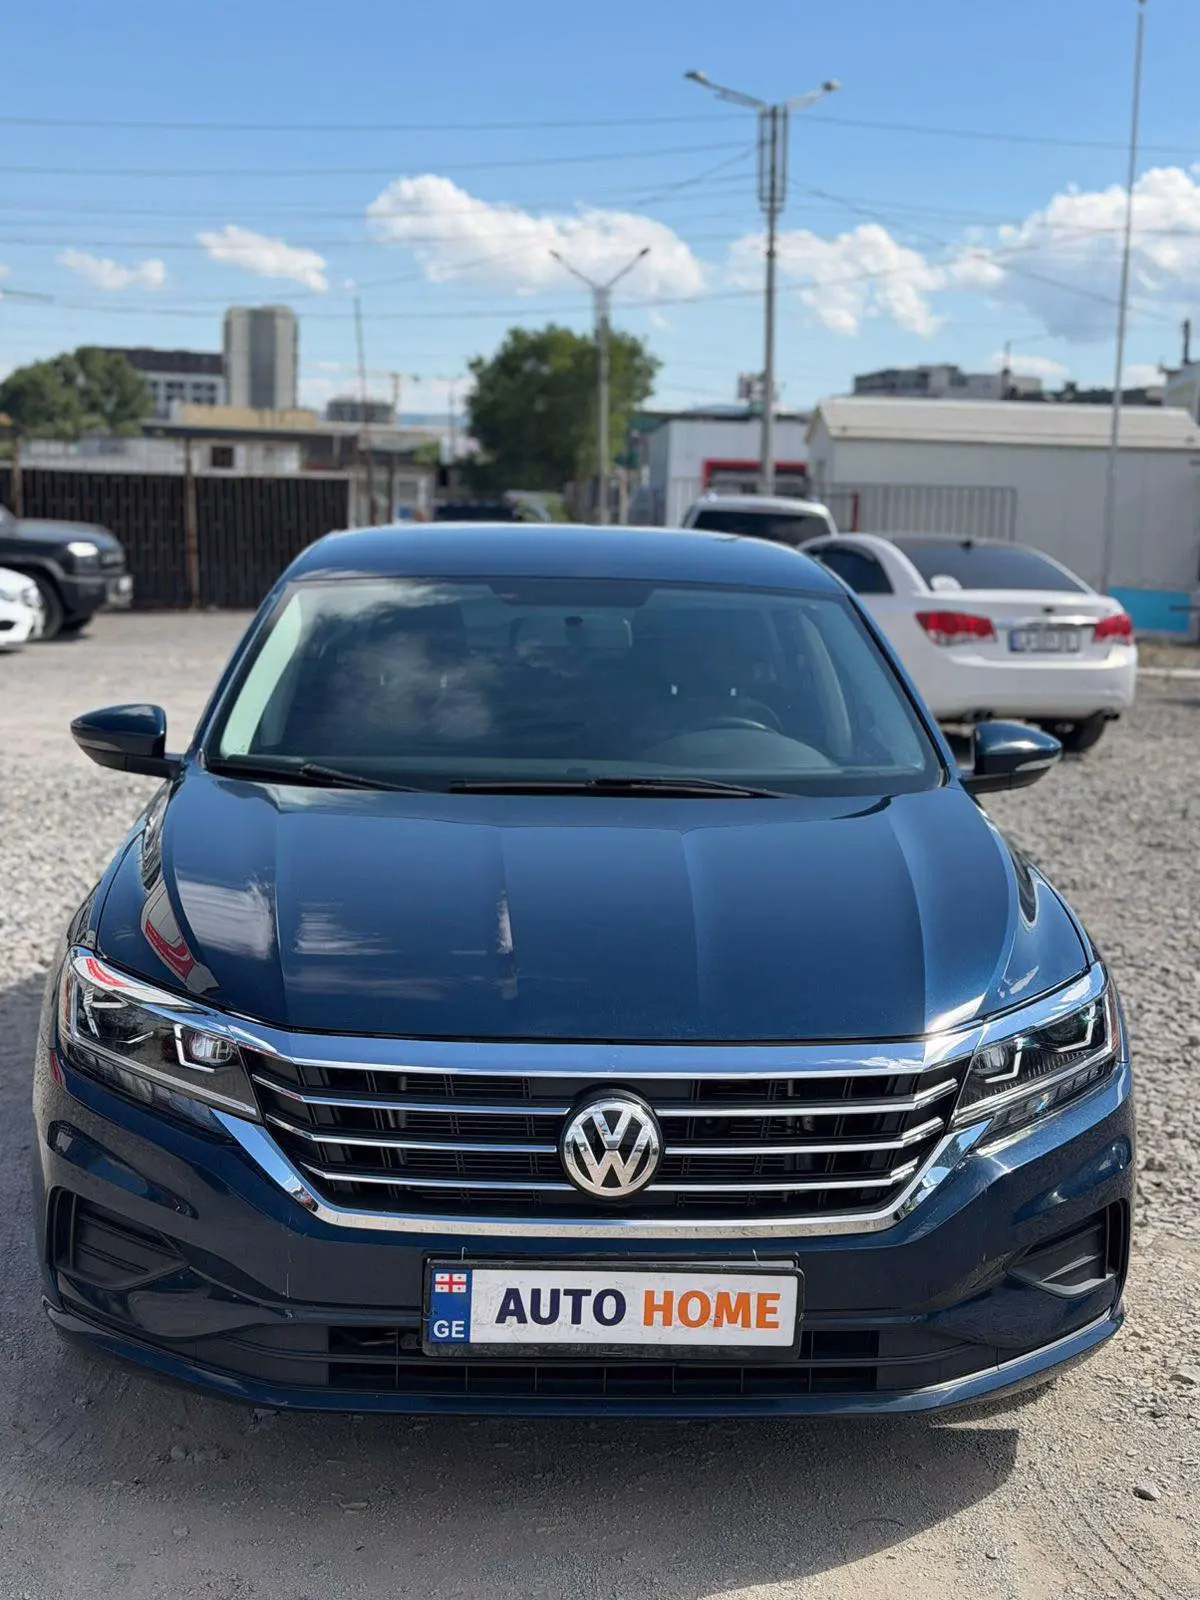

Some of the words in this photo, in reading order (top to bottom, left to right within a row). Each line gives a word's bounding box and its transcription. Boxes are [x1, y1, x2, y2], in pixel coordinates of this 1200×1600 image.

[565, 1099, 659, 1195] VW
[433, 1319, 465, 1339] GE
[495, 1287, 627, 1327] AUTO
[643, 1289, 781, 1330] HOME
